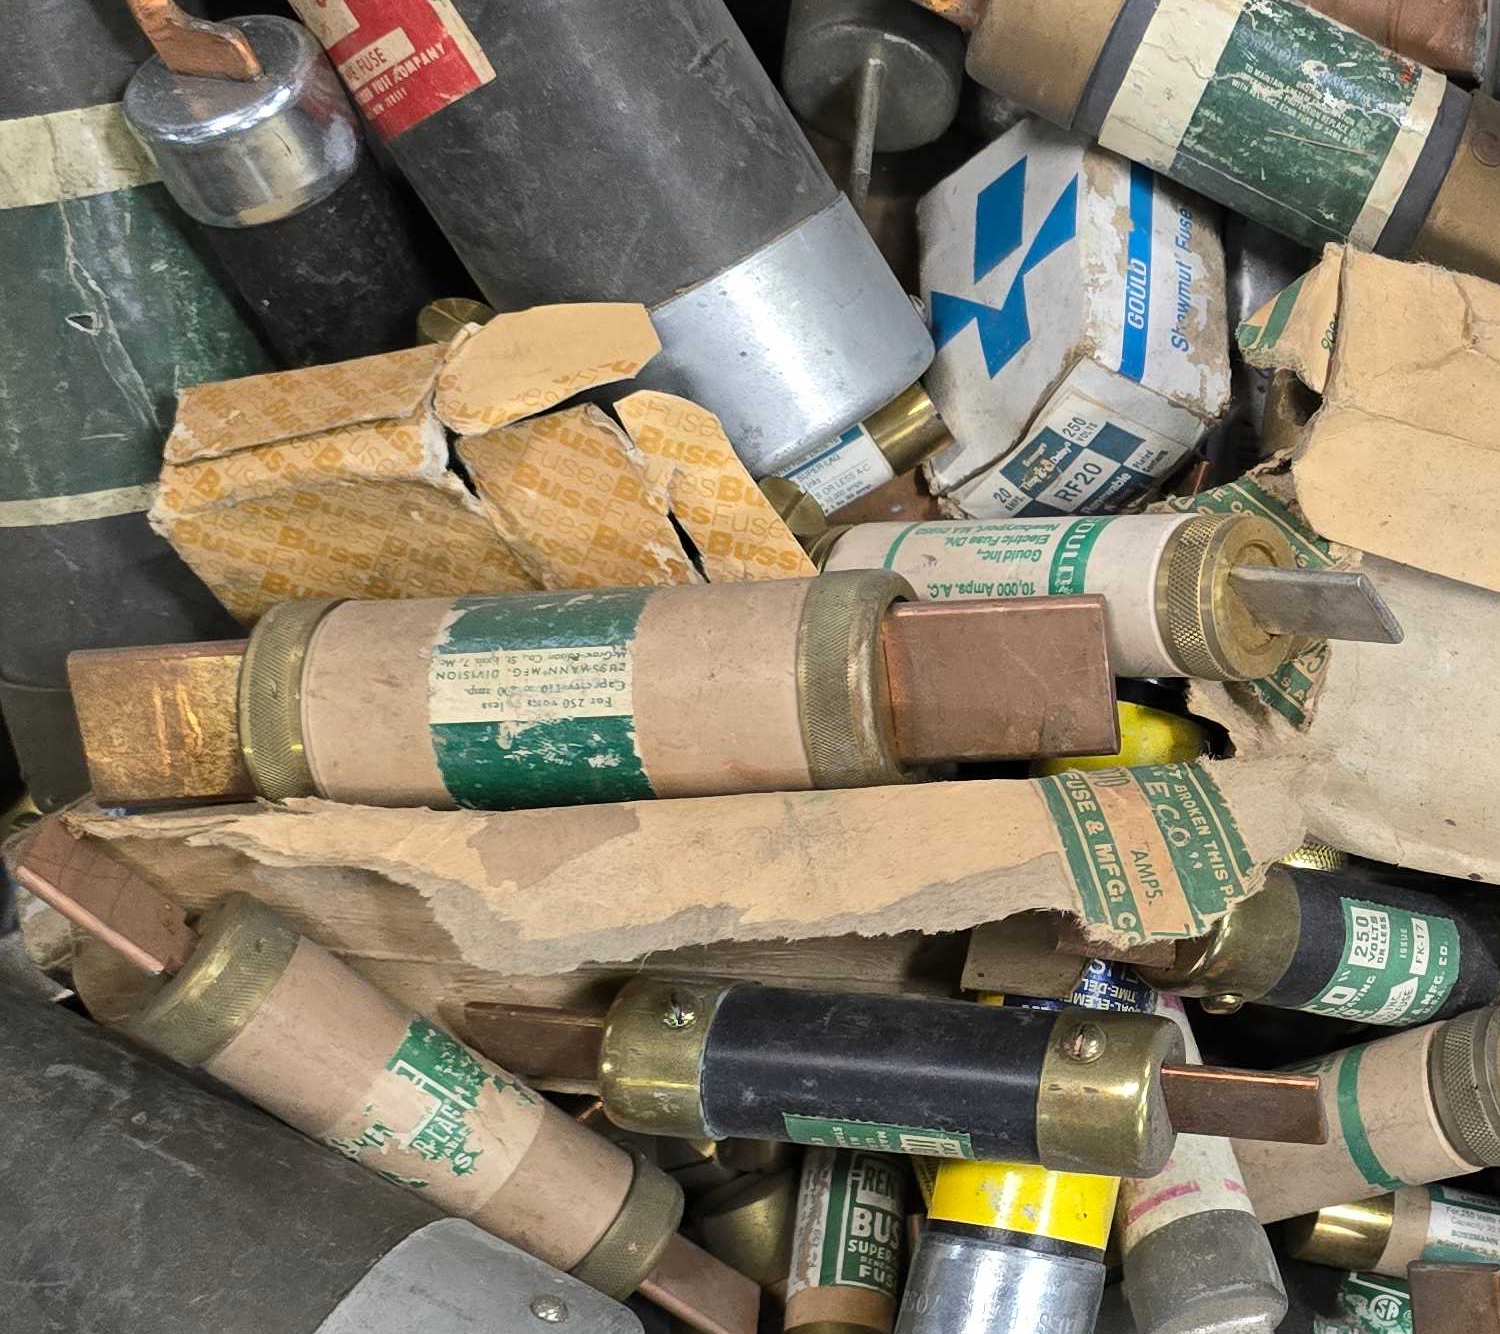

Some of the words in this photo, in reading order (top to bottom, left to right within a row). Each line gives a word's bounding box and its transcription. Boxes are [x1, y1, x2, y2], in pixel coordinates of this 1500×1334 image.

[354, 44, 388, 75] FUSE
[1126, 257, 1148, 331] GOULD
[1063, 412, 1085, 439] 250
[991, 484, 1013, 506] 20
[1054, 457, 1102, 508] RF20
[1003, 548, 1041, 562] Gould
[927, 583, 952, 597] A.C.
[955, 580, 993, 596] Amps.
[996, 580, 1036, 596] 10,000
[435, 668, 500, 680] DIVISION
[1173, 779, 1211, 839] BROKEN
[1201, 839, 1231, 882] THIS
[1123, 842, 1171, 907] AMPS.
[1352, 914, 1369, 957] 250
[1367, 915, 1379, 962] VOLTS
[1413, 922, 1425, 964] FK-17
